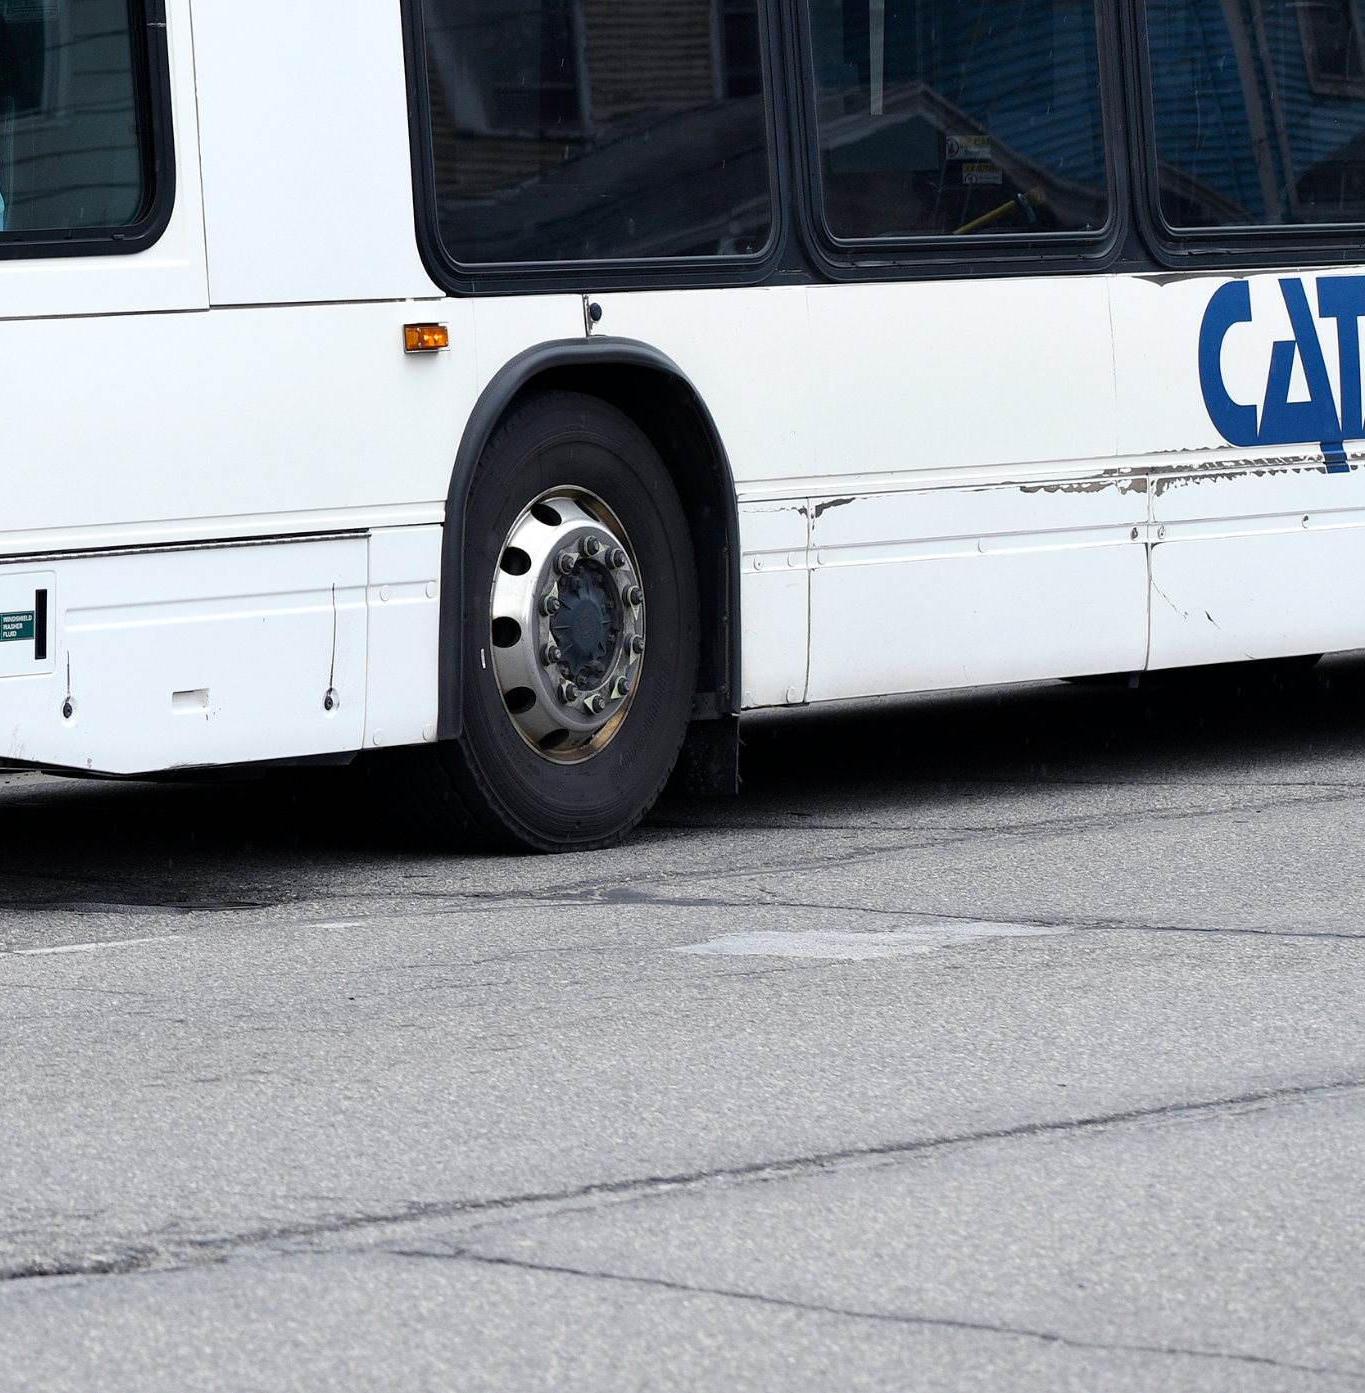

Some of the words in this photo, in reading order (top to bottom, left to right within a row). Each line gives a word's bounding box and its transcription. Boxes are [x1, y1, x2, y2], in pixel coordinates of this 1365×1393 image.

[1198, 277, 1365, 474] CAT
[2, 614, 32, 622] WINDSHIELD
[2, 622, 24, 630] WASHER
